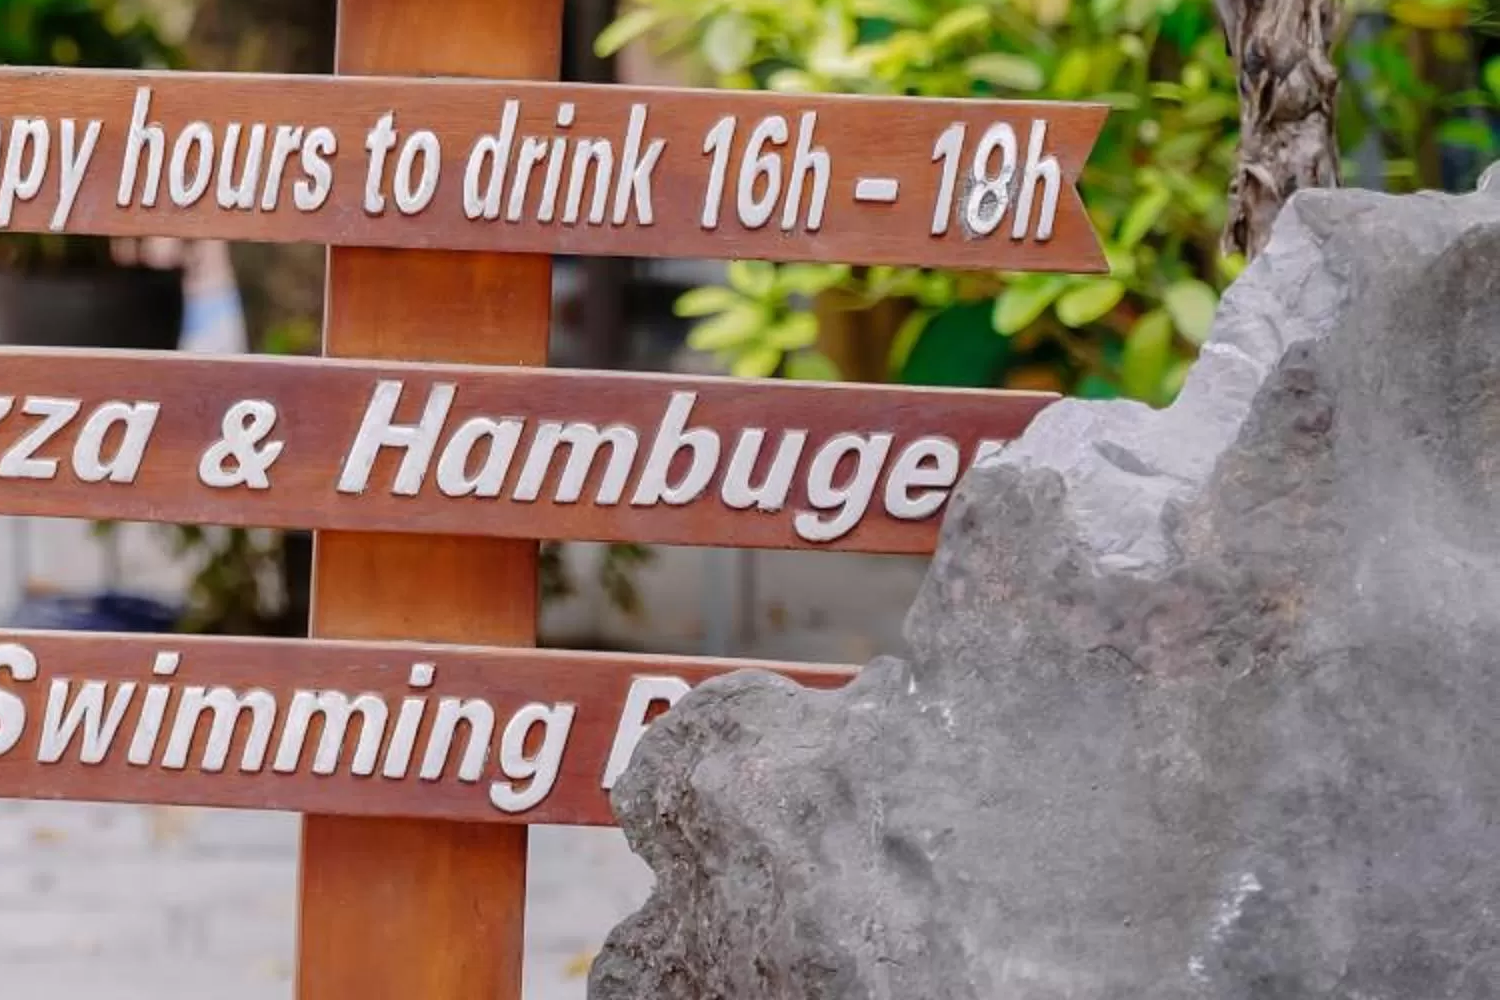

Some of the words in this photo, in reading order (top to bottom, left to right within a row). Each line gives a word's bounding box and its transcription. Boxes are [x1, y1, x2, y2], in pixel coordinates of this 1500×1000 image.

[117, 86, 338, 212] hours
[365, 110, 442, 217] to
[463, 99, 666, 226] drink
[702, 111, 832, 231] 16h
[931, 119, 1061, 240] 18h
[198, 399, 285, 490] &
[336, 379, 1005, 542] Hambuge
